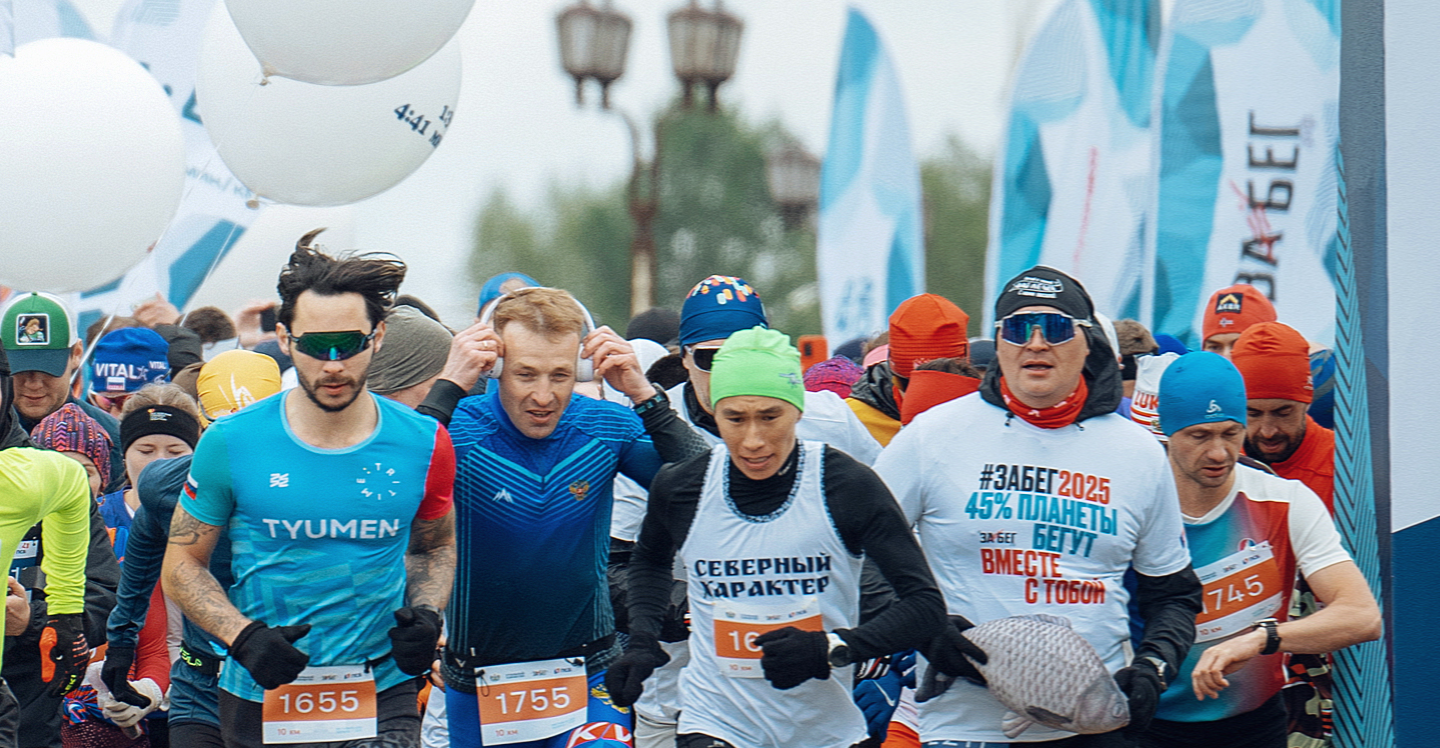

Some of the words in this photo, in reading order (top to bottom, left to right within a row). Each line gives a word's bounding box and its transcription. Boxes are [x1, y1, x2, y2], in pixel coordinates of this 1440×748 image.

[394, 103, 432, 136] 4:41
[964, 491, 1013, 520] 45%
[1017, 493, 1118, 536] ПЛАНЕТЫ
[262, 518, 399, 539] TYUMEN
[1032, 523, 1098, 558] БЕГУТ
[694, 552, 831, 577] СЕВЕРНЫЙ
[980, 548, 1062, 578] ВМЕСТЕ
[700, 576, 829, 598] ХАРАКТЕР
[1025, 578, 1039, 604] С
[1043, 577, 1106, 604] ТОБОЙ
[728, 630, 761, 652] 16
[278, 690, 359, 713] 1655
[495, 686, 571, 714] 1755
